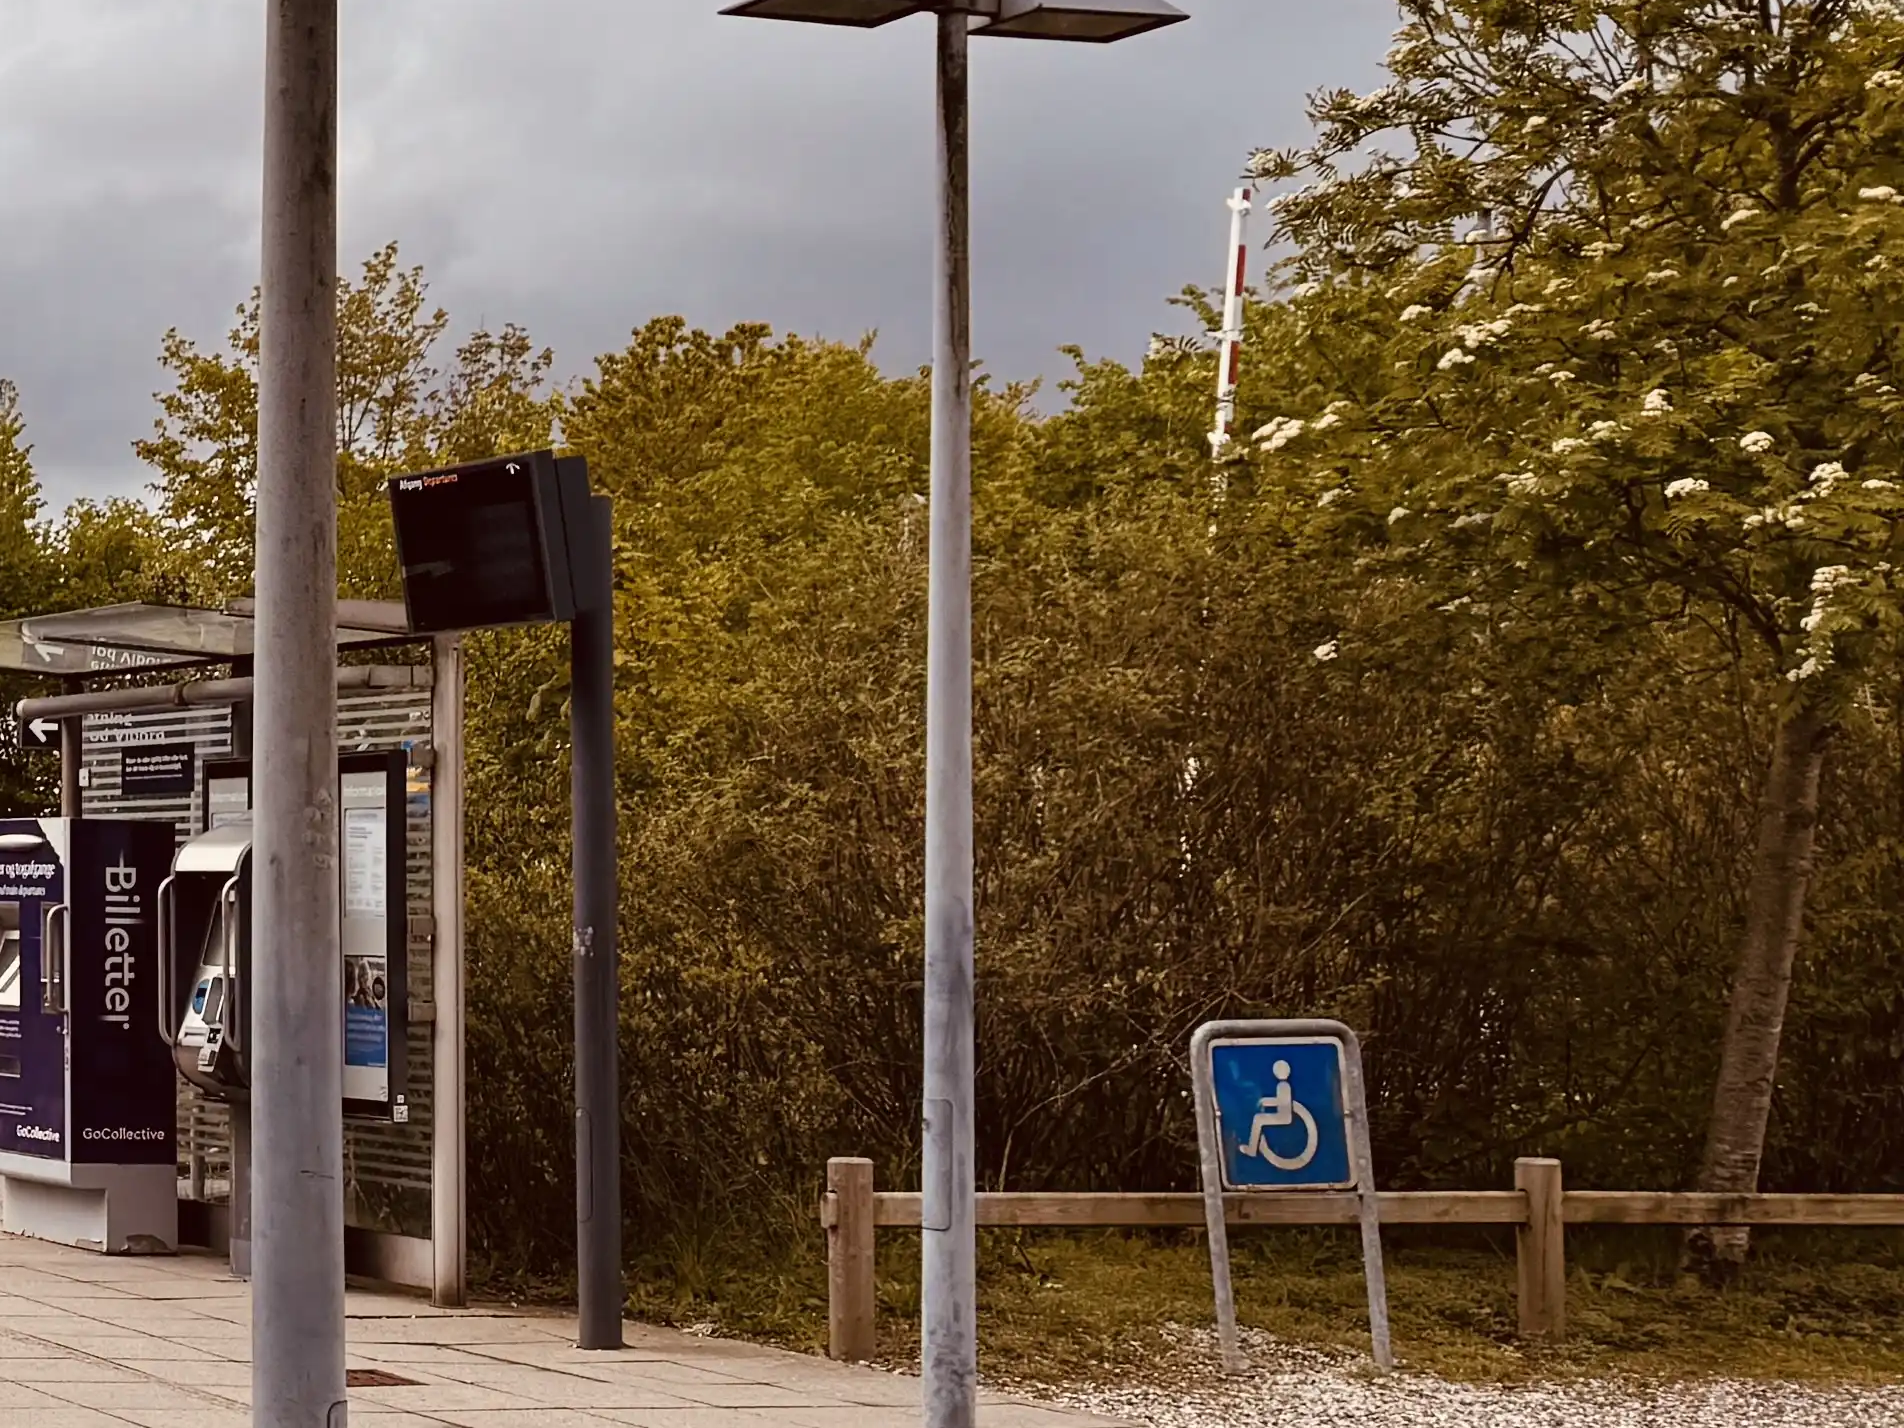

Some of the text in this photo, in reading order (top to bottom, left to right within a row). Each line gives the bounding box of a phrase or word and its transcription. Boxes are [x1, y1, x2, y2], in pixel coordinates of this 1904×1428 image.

[99, 851, 144, 1030] Billetter
[16, 1124, 60, 1142] GoCollective
[82, 1127, 165, 1140] GoCollective
